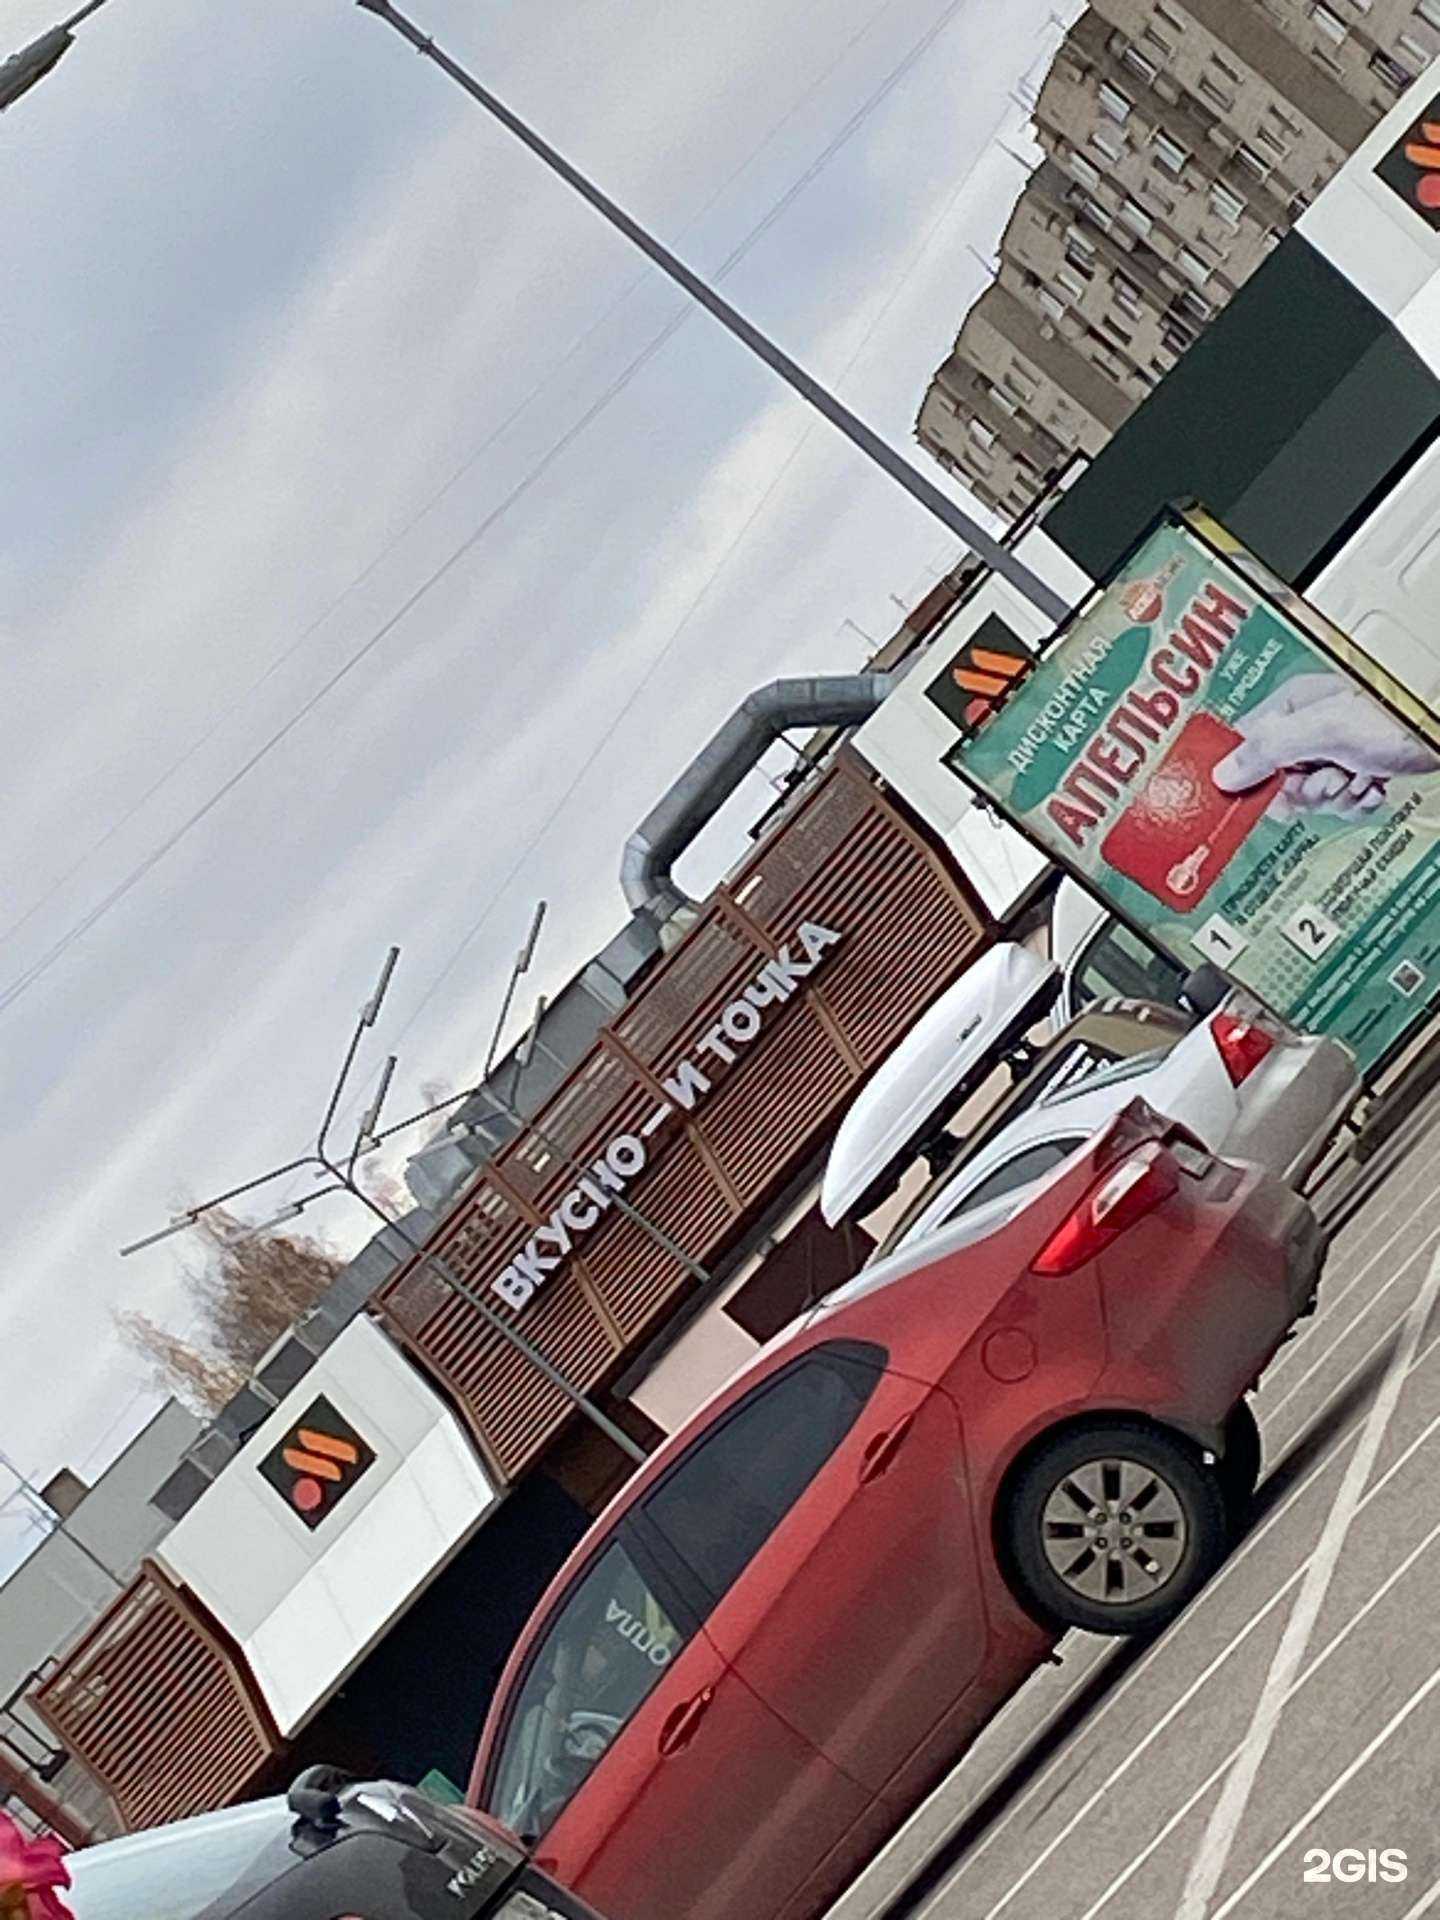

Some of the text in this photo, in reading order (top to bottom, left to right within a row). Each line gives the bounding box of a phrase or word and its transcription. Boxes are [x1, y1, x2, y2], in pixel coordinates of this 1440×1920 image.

[1219, 648, 1249, 681] УЖЕ
[1228, 638, 1284, 706] ПРОДАЖЕ
[1008, 636, 1113, 774] ДИСКОНТНАЯ
[1046, 582, 1248, 848] АПЕЛЬСИН
[1053, 686, 1111, 753] КАРТА
[1209, 928, 1233, 951] 1
[1298, 918, 1327, 945] 2
[491, 1134, 647, 1311] ВКУСНО
[663, 1060, 711, 1110] И
[696, 921, 842, 1065] ТОЧКА
